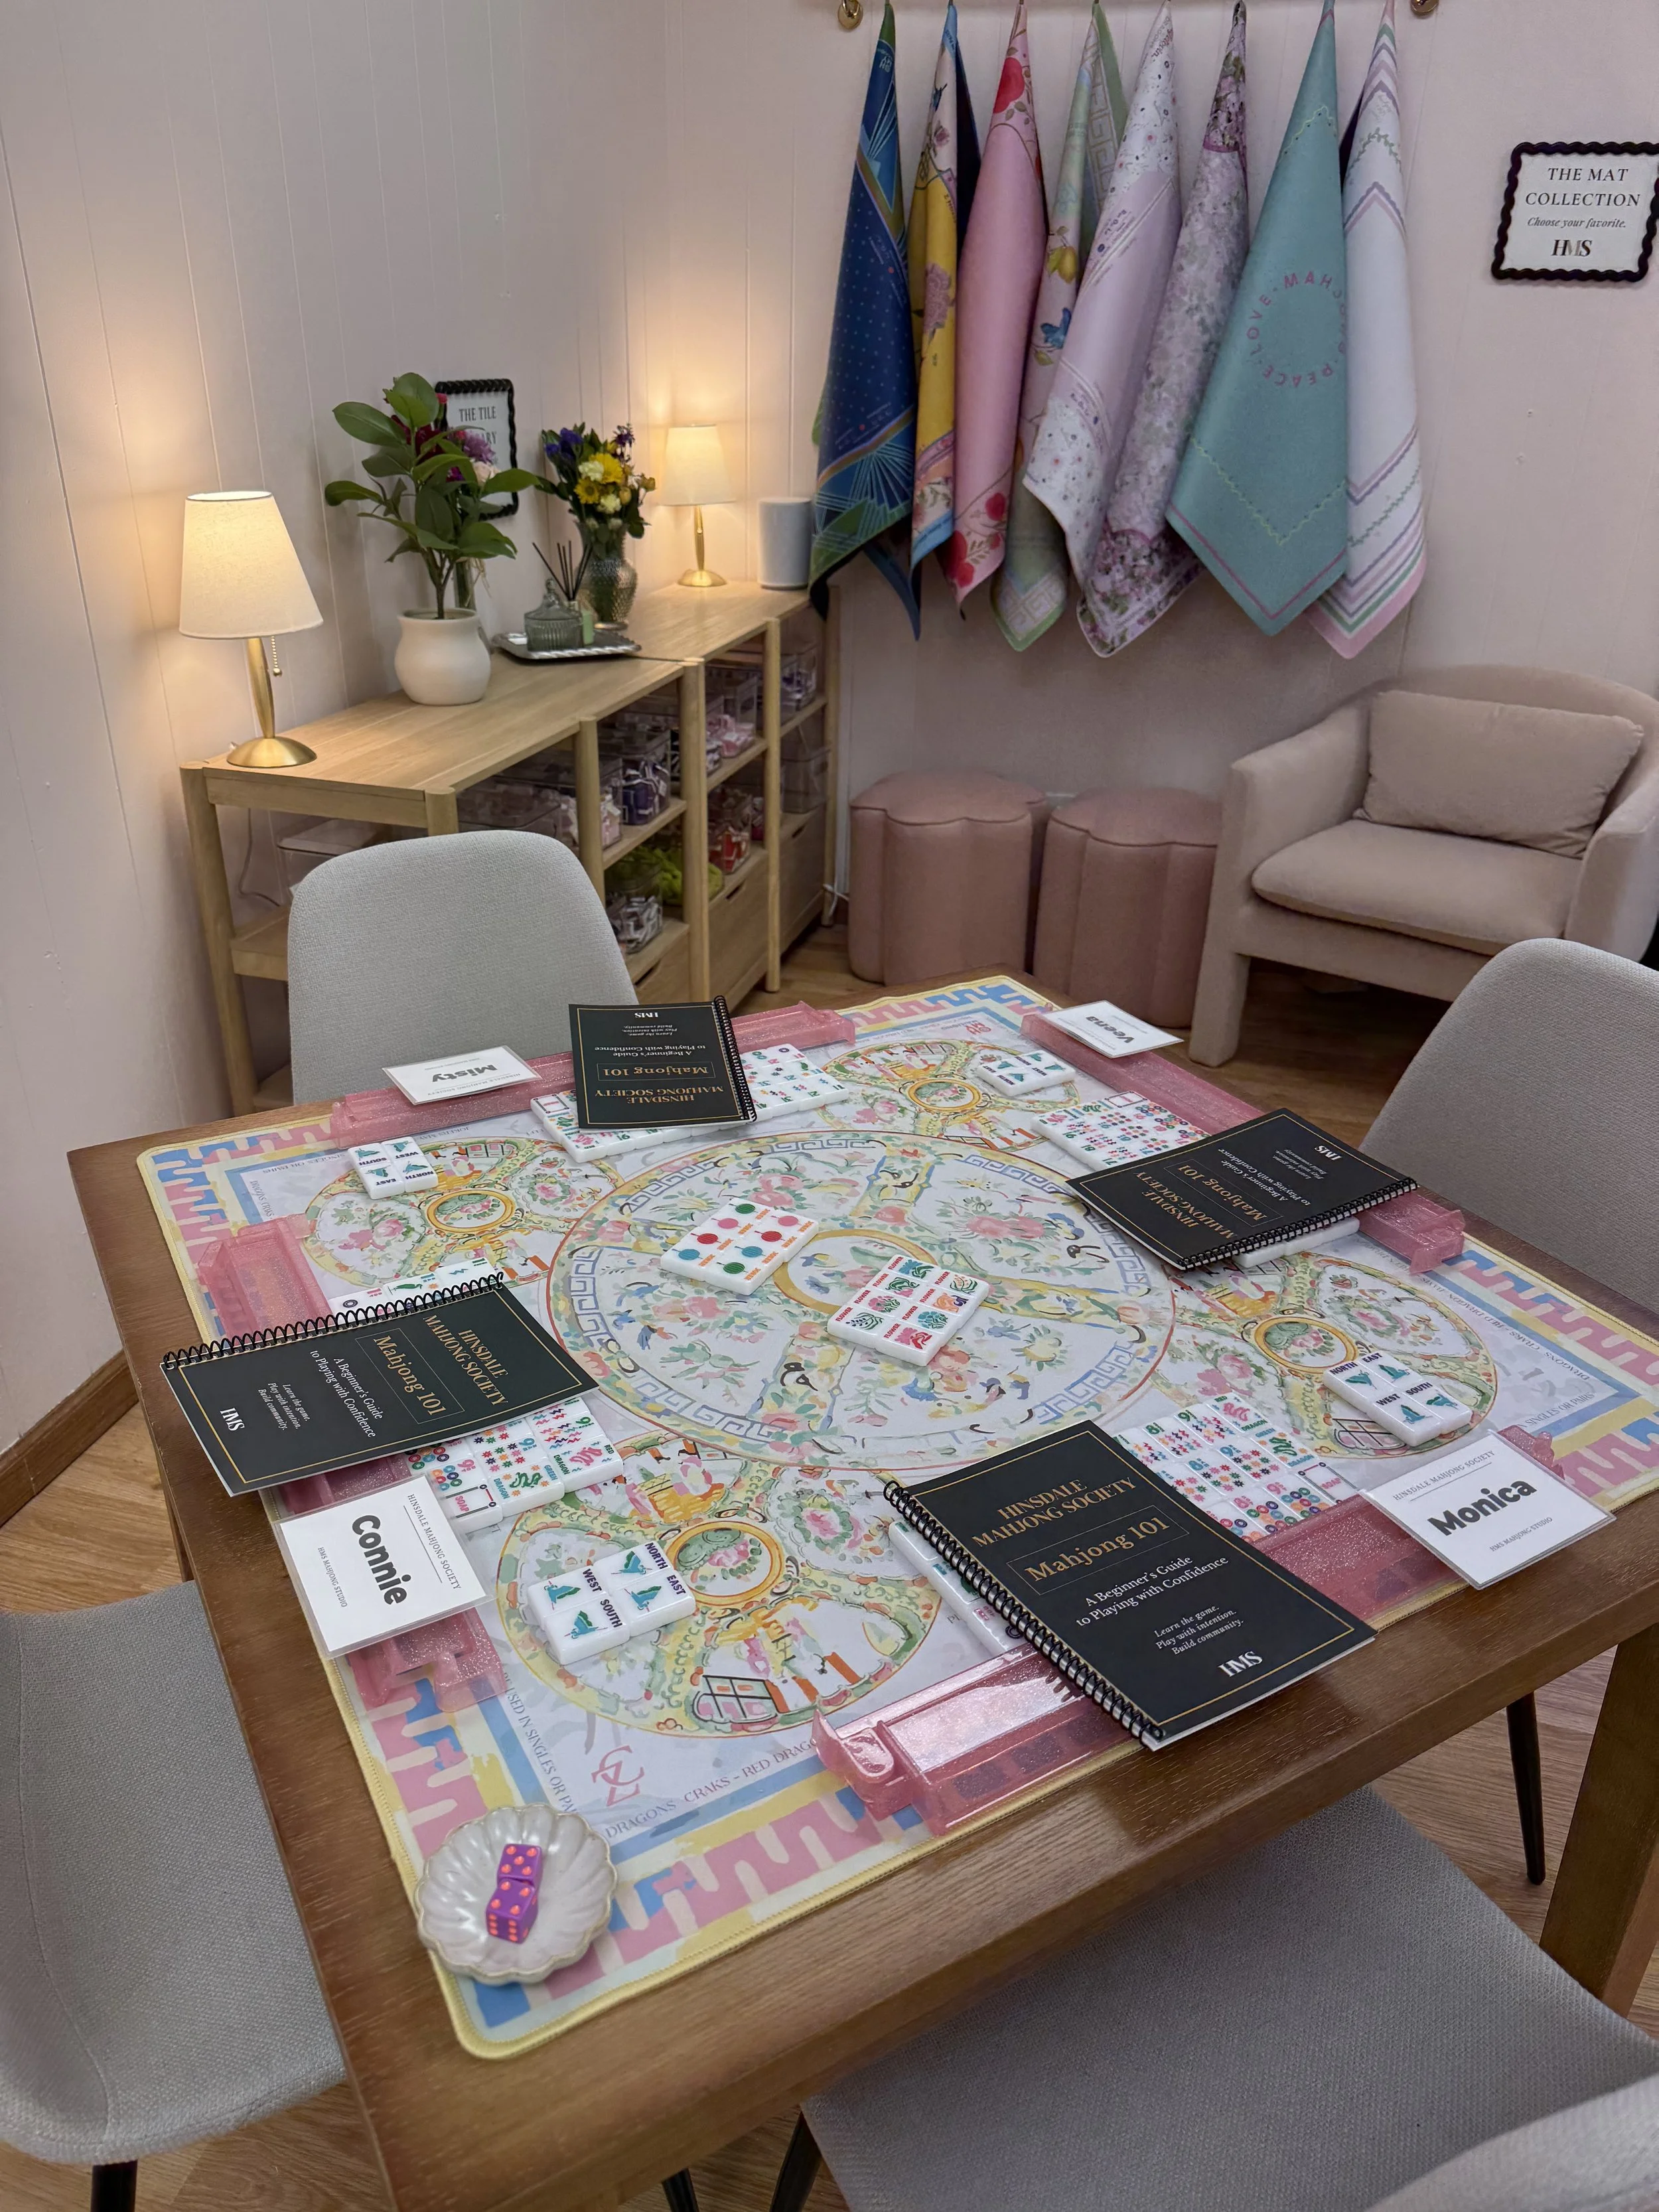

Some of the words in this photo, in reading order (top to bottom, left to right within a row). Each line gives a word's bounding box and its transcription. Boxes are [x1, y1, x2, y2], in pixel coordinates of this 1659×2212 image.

[1548, 168, 1581, 181] THE
[1587, 168, 1628, 181] MAT
[1526, 192, 1640, 206] COLLECTION
[1527, 217, 1559, 226] Choose
[1561, 219, 1584, 228] your
[1585, 218, 1626, 228] favorite.
[1551, 240, 1593, 257] HMS
[459, 407, 476, 422] THE
[478, 406, 497, 421] TILE
[1086, 1015, 1135, 1043] Veena
[431, 1065, 498, 1082] Misty
[634, 1067, 709, 1075] Mahjong
[626, 1095, 695, 1104] HINSDALE
[656, 1086, 724, 1095] MAHJONG
[359, 1157, 388, 1166] SOUTH
[1218, 1147, 1258, 1174] Confidence
[1221, 1159, 1243, 1175] Guide
[405, 1171, 434, 1180] NORTH
[1178, 1165, 1205, 1181] 101
[1256, 1172, 1276, 1185] with
[1133, 1171, 1183, 1203] SOCIETY
[1242, 1173, 1279, 1198] Beginner's
[1273, 1181, 1301, 1201] Playing
[1141, 1189, 1199, 1228] HINSDALE
[1202, 1178, 1268, 1221] Mahjong
[1177, 1199, 1238, 1239] MAHJONG
[888, 1256, 904, 1270] FLOWER
[872, 1273, 889, 1288] FLOWER
[934, 1271, 950, 1286] FLOWER
[854, 1290, 871, 1304] FLOWER
[919, 1288, 936, 1303] FLOWER
[1449, 1293, 1484, 1318] DRAGON
[835, 1306, 853, 1322] FLOWER
[902, 1305, 918, 1321] FLOWER
[1484, 1316, 1504, 1329] RED
[883, 1322, 901, 1339] FLOWER
[1509, 1331, 1541, 1351] CRAKS
[423, 1315, 470, 1363] MAHJONG
[462, 1361, 508, 1406] SOCIETY
[458, 1329, 508, 1378] HINSDALE
[1362, 1353, 1383, 1363] EAST
[374, 1335, 425, 1393] Mahjong
[417, 1392, 447, 1416] 101
[1329, 1362, 1358, 1375] NORTH
[1544, 1351, 1590, 1381] DRAGONS
[310, 1350, 320, 1359] to
[315, 1358, 337, 1384] Playing
[332, 1382, 348, 1399] with
[344, 1398, 377, 1438] Confidence
[338, 1363, 369, 1398] Beginner's
[363, 1397, 383, 1420] Guide
[1406, 1382, 1433, 1395] SOUTH
[258, 1388, 273, 1402] Build
[267, 1402, 288, 1430] community.
[267, 1382, 279, 1394] Play
[275, 1393, 288, 1406] with
[282, 1404, 301, 1430] intention.
[282, 1384, 297, 1400] Learn
[298, 1405, 311, 1422] game.
[1376, 1393, 1402, 1406] WEST
[1524, 1408, 1560, 1428] SINGLES
[1571, 1392, 1595, 1408] PAIRS
[220, 1407, 246, 1432] HMS
[1241, 1419, 1267, 1432] DRAGON
[1255, 1428, 1275, 1438] GREEN
[604, 1444, 614, 1455] RED
[553, 1455, 570, 1475] DRAGON
[1287, 1454, 1315, 1467] DRAGON
[544, 1465, 557, 1481] GREEN
[1320, 1477, 1341, 1490] SOAP
[1393, 1479, 1431, 1501] HINSDALE
[1431, 1464, 1465, 1485] MAHJONG
[1465, 1450, 1496, 1467] SOCIETY
[493, 1478, 510, 1499] DRAGON
[455, 1495, 469, 1512] SOAP
[997, 1479, 1089, 1520] HINSDALE
[1427, 1481, 1538, 1536] Monica
[972, 1506, 1064, 1548] MAHJONG
[1062, 1477, 1137, 1514] SOCIETY
[407, 1494, 429, 1527] HINSDALE
[424, 1526, 445, 1560] MAHJONG
[440, 1559, 461, 1590] SOCIETY
[1489, 1540, 1506, 1552] HMS
[1504, 1527, 1532, 1545] MAHJONG
[1530, 1516, 1553, 1533] STUDIO
[352, 1514, 411, 1605] Connie
[644, 1542, 668, 1570] NORTH
[1024, 1533, 1135, 1582] Mahjong
[1127, 1516, 1170, 1540] 101
[318, 1547, 327, 1560] HMS
[323, 1559, 337, 1586] MAHJONG
[334, 1585, 348, 1608] STUDIO
[582, 1568, 603, 1591] WEST
[666, 1574, 686, 1595] EAST
[1085, 1596, 1096, 1607] A
[1093, 1572, 1158, 1601] Beginner's
[1155, 1556, 1193, 1576] Guide
[1076, 1616, 1090, 1627] to
[1090, 1595, 1139, 1623] Playing
[1136, 1584, 1165, 1603] with
[1162, 1556, 1229, 1589] Confidence
[600, 1599, 623, 1628] SOUTH
[1153, 1623, 1181, 1638] Learn
[1181, 1615, 1194, 1626] the
[1195, 1605, 1220, 1620] game.
[1155, 1637, 1177, 1649] Play
[1176, 1627, 1196, 1640] with
[1196, 1609, 1237, 1631] intention.
[1171, 1639, 1196, 1655] Build
[1197, 1618, 1244, 1644] community.
[1217, 1651, 1263, 1677] HMS
[506, 1687, 526, 1715] USED
[517, 1714, 532, 1731] IN
[524, 1729, 556, 1777] SINGLES
[548, 1775, 563, 1795] OR
[607, 1799, 678, 1838] DRAGONS
[684, 1776, 732, 1803] CRAKS
[741, 1758, 771, 1779] RED
